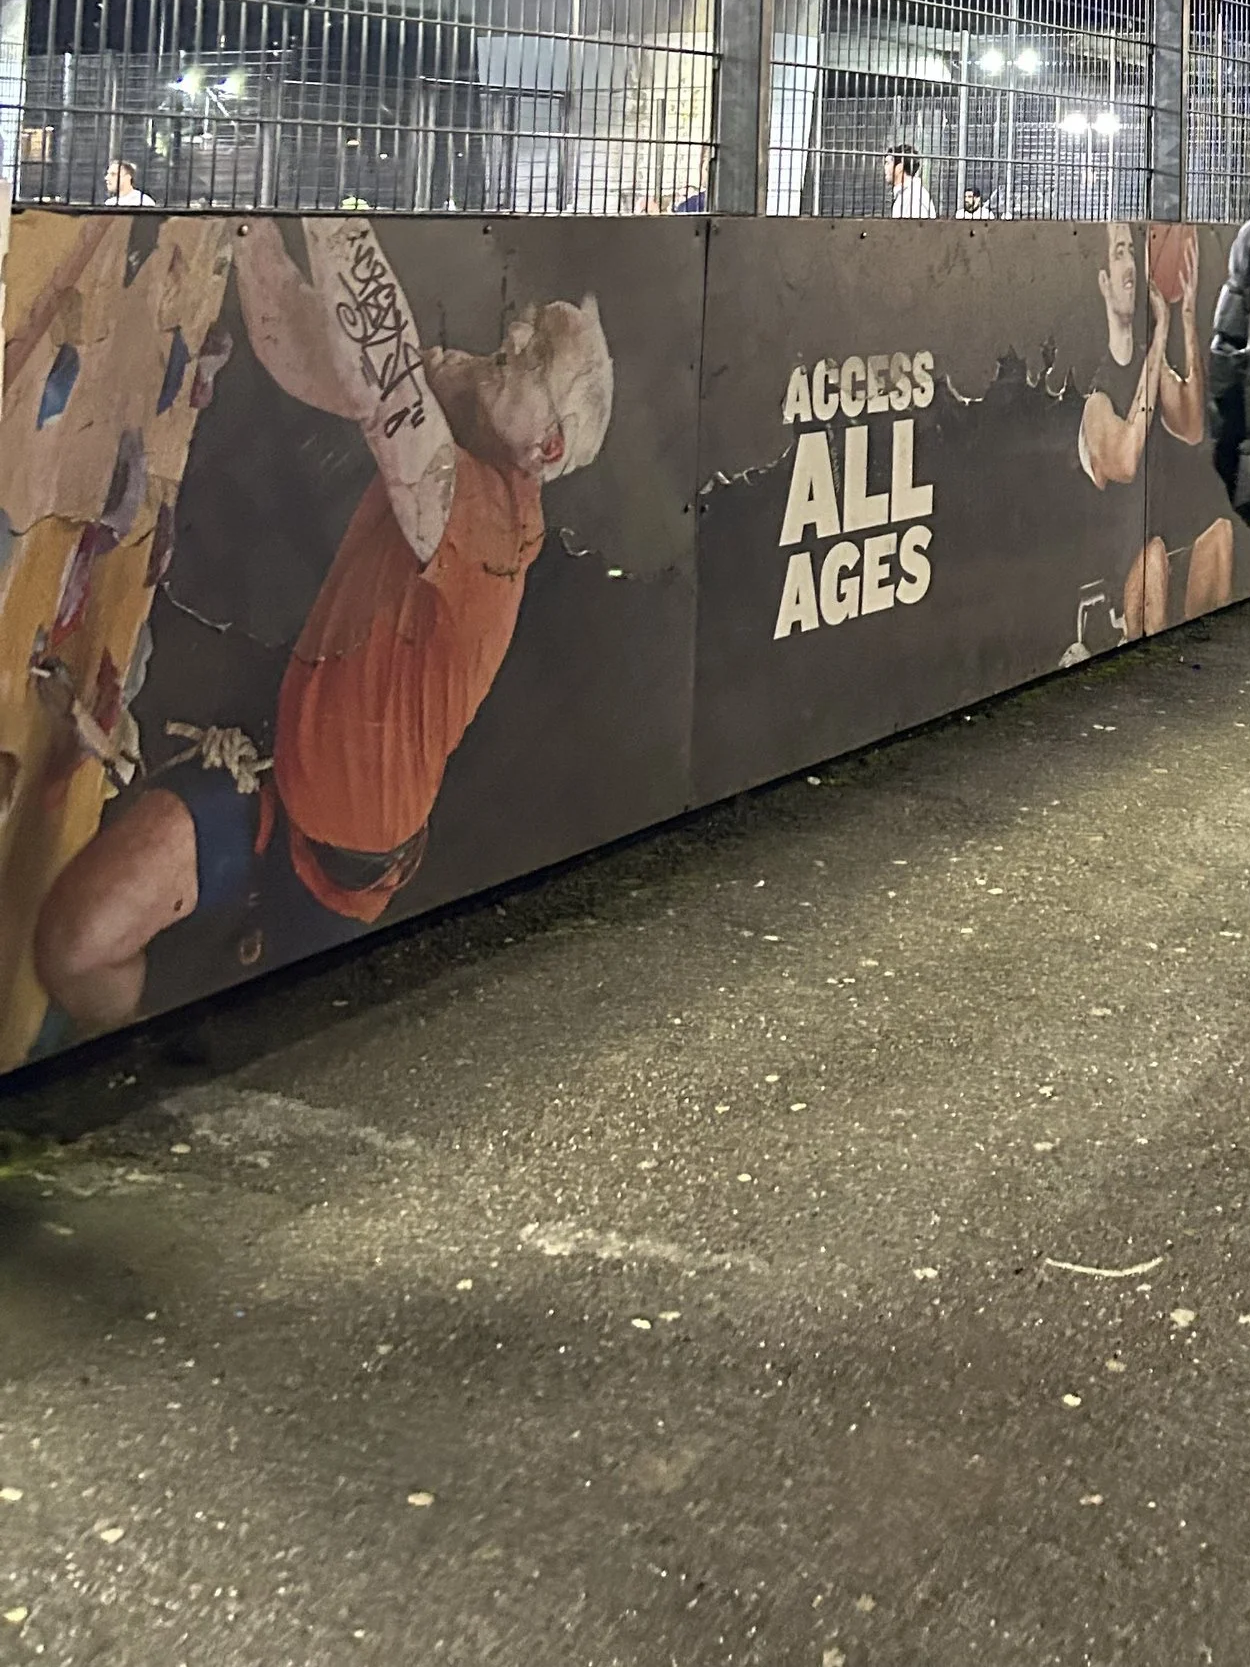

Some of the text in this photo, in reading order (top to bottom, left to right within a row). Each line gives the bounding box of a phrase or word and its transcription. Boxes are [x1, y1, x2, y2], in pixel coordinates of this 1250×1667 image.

[782, 350, 935, 425] ACCESS
[779, 419, 934, 547] ALL
[773, 524, 933, 640] AGES
